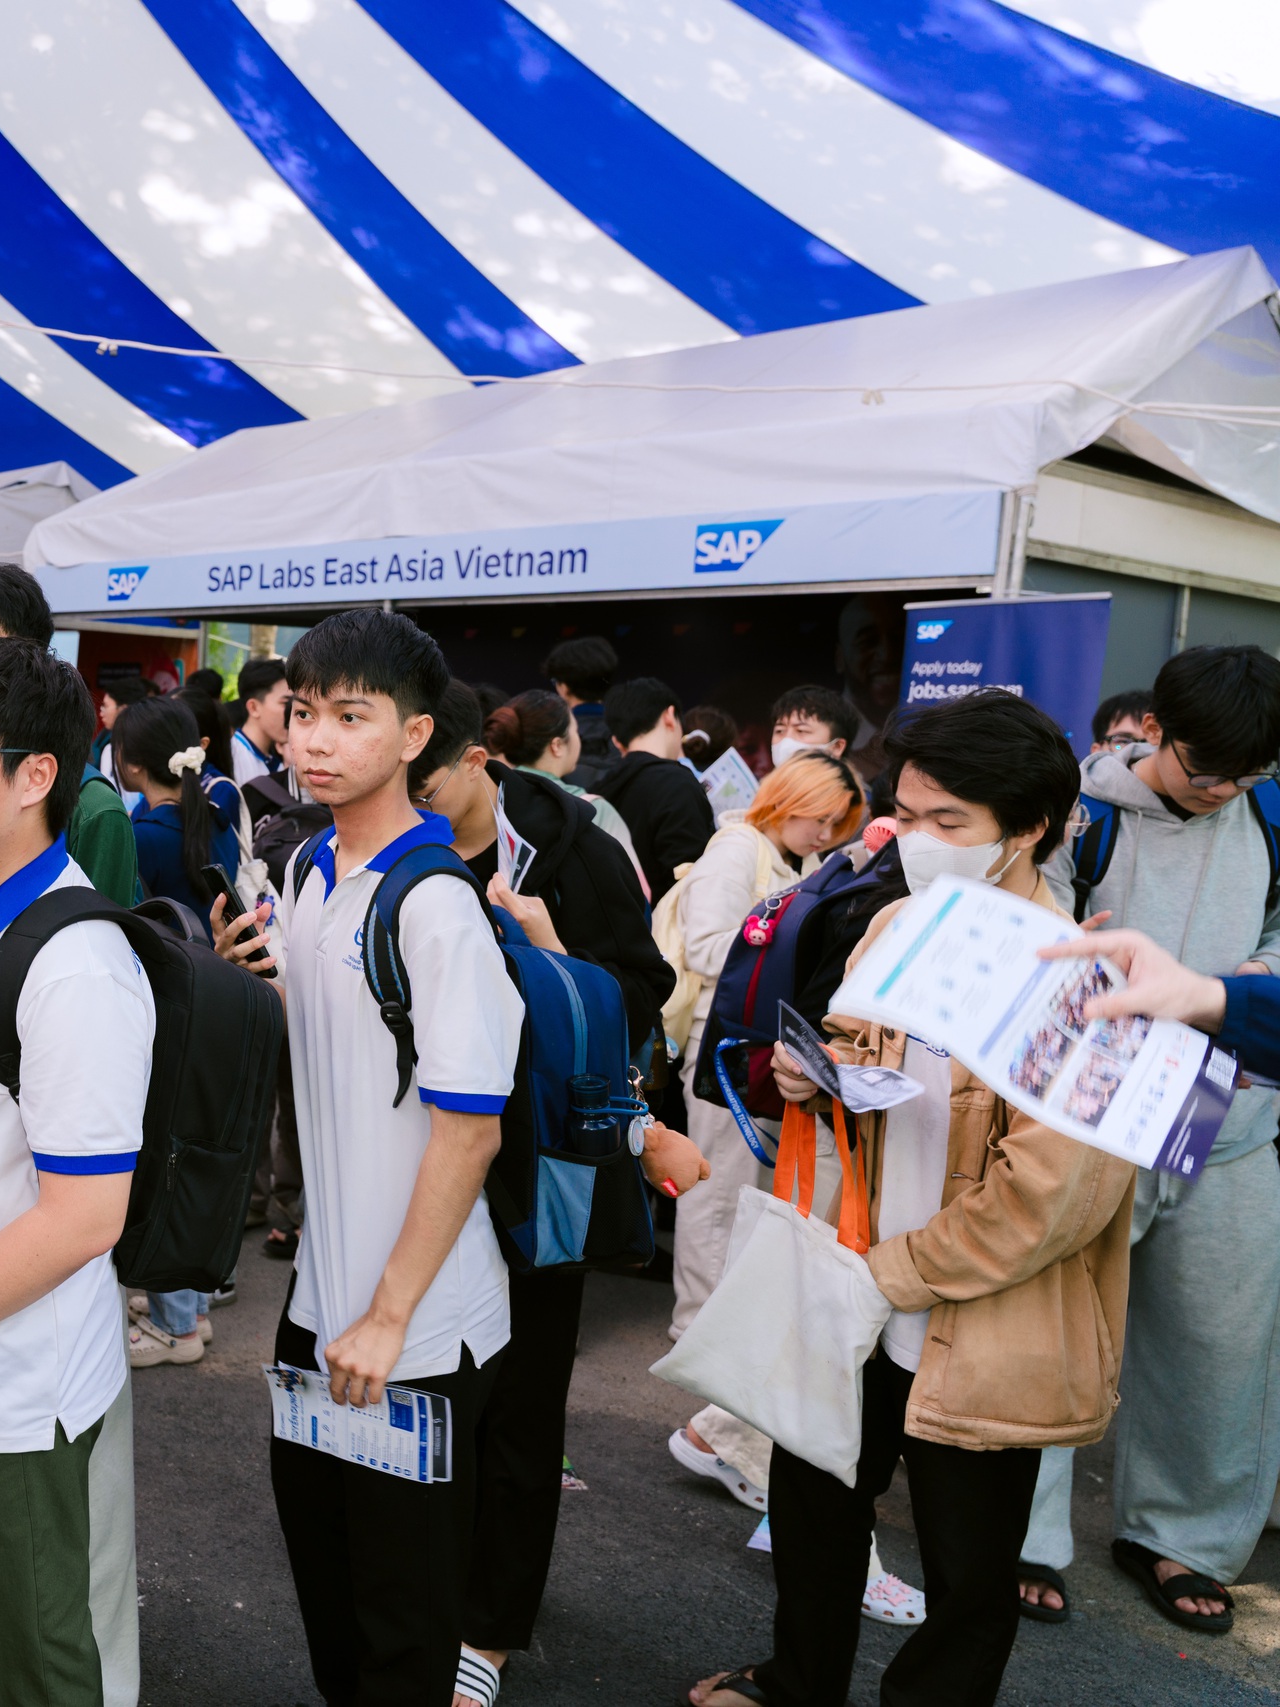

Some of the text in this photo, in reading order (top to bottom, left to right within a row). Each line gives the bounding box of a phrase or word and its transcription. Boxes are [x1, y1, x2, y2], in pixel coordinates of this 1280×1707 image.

[694, 528, 763, 567] SAP
[108, 572, 141, 597] SAP
[207, 545, 588, 593] SAP Labs East Asia Vietnam
[916, 624, 945, 640] SAP
[911, 660, 983, 677] Apply today
[719, 1074, 742, 1115] INFORMATION
[738, 1114, 760, 1149] TECHNOLOGY
